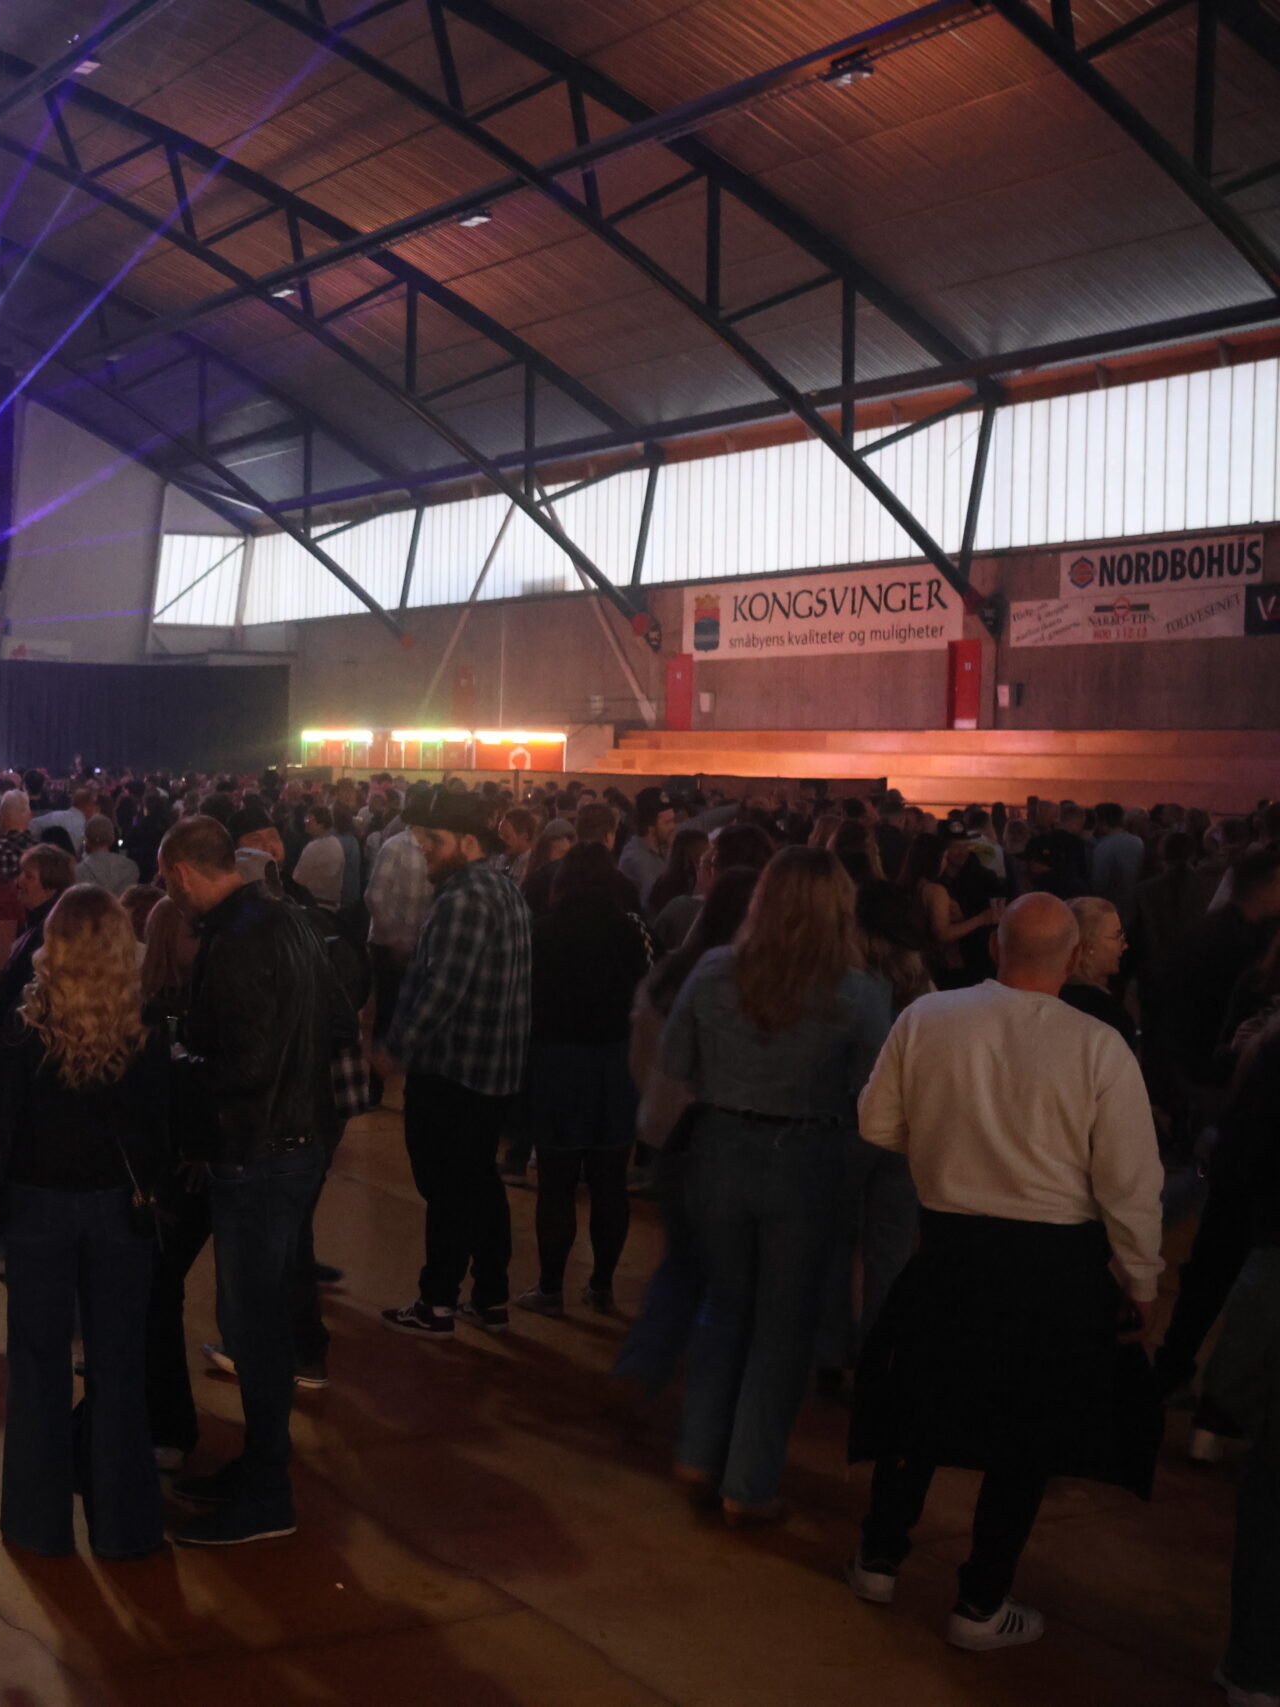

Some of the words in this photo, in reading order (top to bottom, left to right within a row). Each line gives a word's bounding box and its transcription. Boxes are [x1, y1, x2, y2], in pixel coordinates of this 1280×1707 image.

[1099, 540, 1262, 587] NORDBOHUS
[732, 579, 948, 623] KONGSVINGER
[729, 632, 785, 650] småbyens
[787, 629, 845, 645] kvaliteter
[849, 630, 866, 646] og
[870, 625, 944, 643] muligheter
